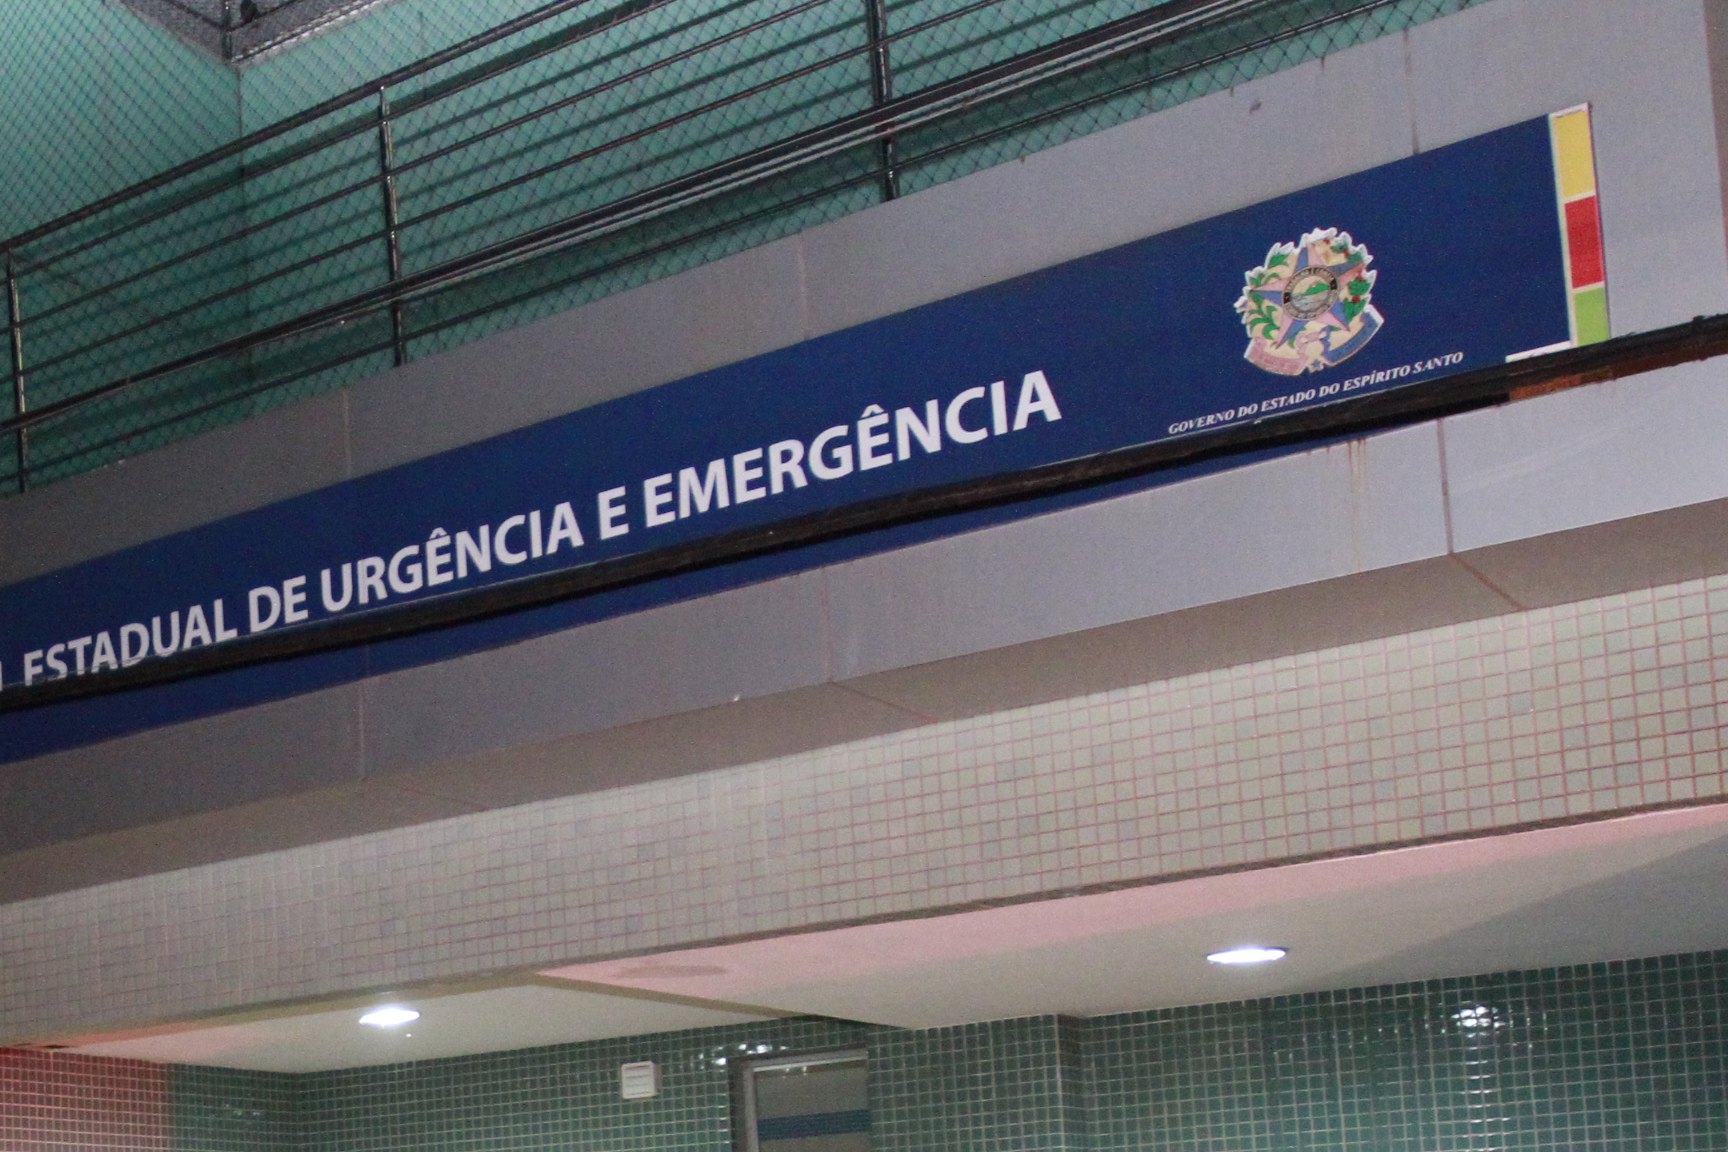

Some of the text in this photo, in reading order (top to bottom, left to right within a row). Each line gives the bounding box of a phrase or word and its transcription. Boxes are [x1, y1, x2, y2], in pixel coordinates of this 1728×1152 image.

[1168, 351, 1464, 435] GOVERNO DO ESTADO DO ESPÍRITO SANTO
[23, 598, 238, 688] ESTADUAL
[248, 575, 308, 633] DE
[321, 501, 583, 612] URGÊNCIA
[598, 485, 629, 540] E
[644, 370, 1062, 528] EMERGÊNCIA
